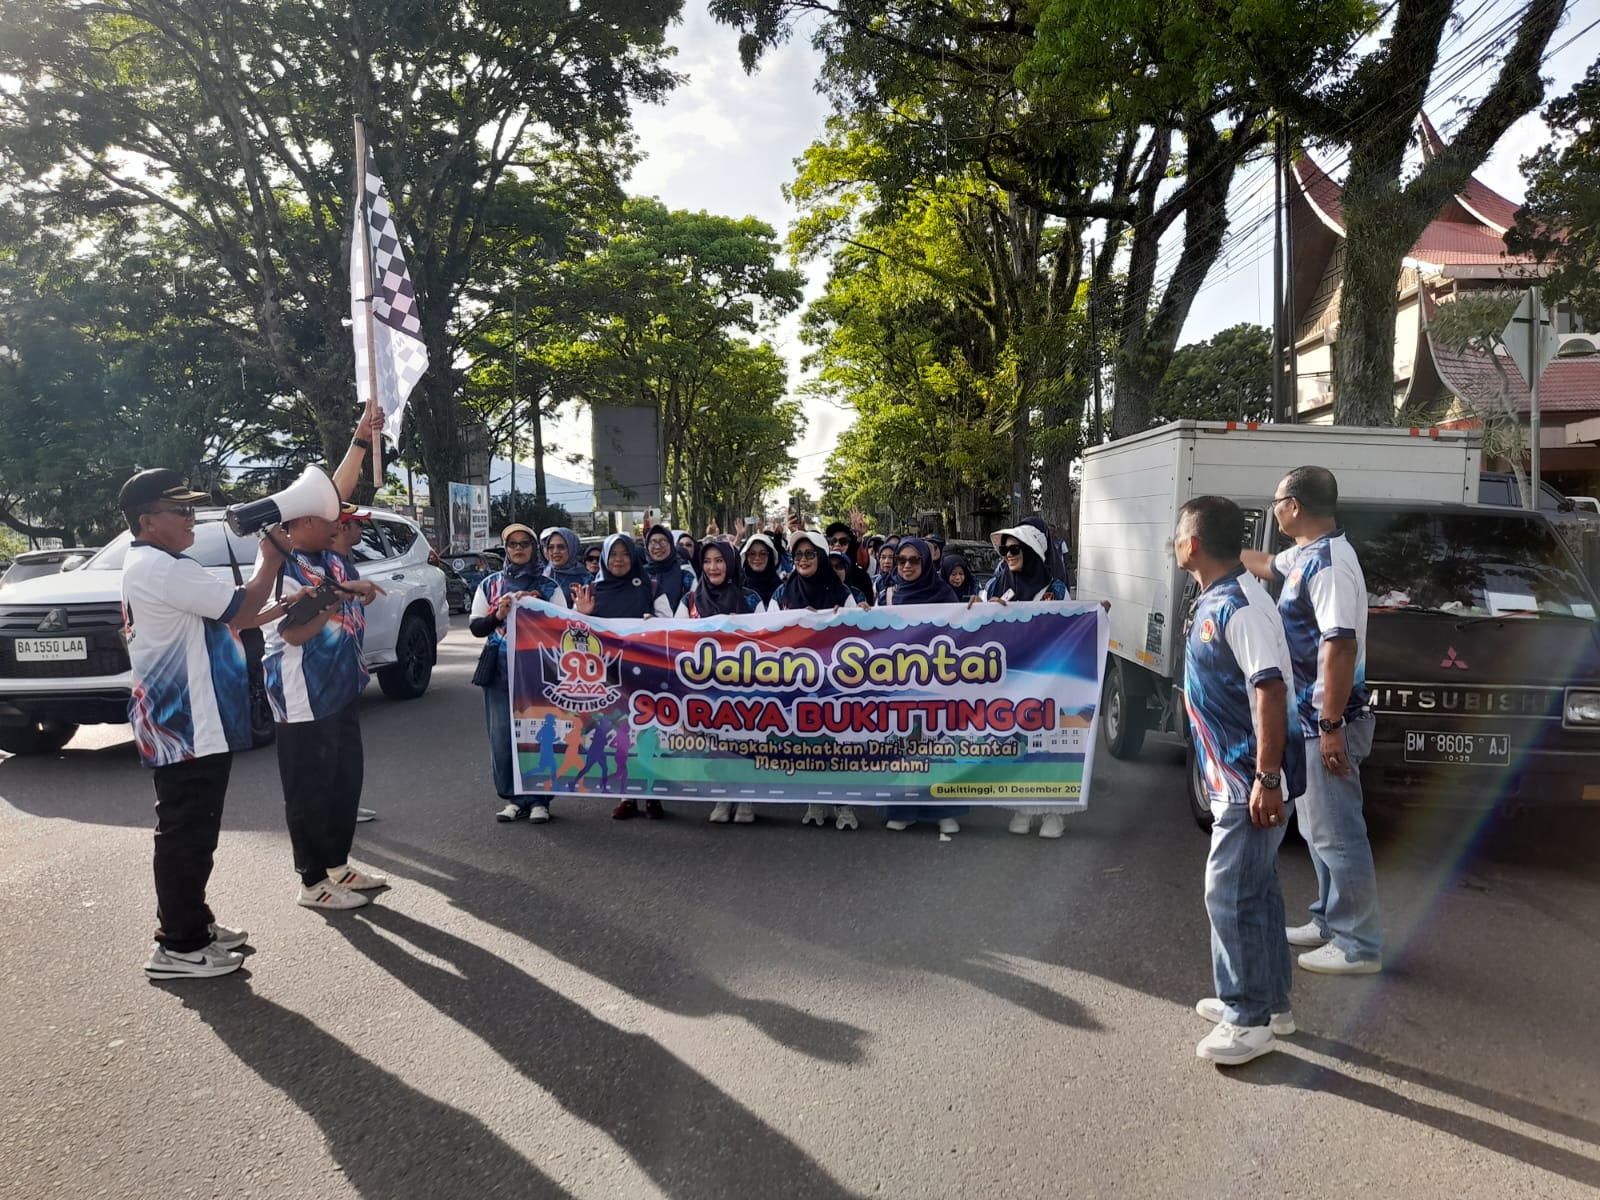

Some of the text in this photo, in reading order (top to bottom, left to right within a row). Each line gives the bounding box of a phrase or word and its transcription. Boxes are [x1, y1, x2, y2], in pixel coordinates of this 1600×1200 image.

[17, 640, 83, 653] BA 1550 LAA
[561, 651, 604, 682] 90
[681, 643, 1001, 686] Jalan Santai
[544, 687, 619, 711] BUKITTINGGI
[556, 683, 608, 696] RAYA
[633, 694, 1056, 732] 90 RAYA BUKITTINGGI
[669, 735, 706, 751] 1000
[710, 735, 778, 755] Langkah
[783, 741, 864, 757] Sehatkan
[907, 740, 955, 756] Jalan
[959, 741, 1019, 757] Santai
[1406, 733, 1508, 756] BM 8605 AJ
[754, 755, 930, 775] Menjalin Silaturahmi
[936, 785, 996, 795] Bukittinggi,
[998, 785, 1008, 793] 01
[1011, 785, 1061, 794] Desember
